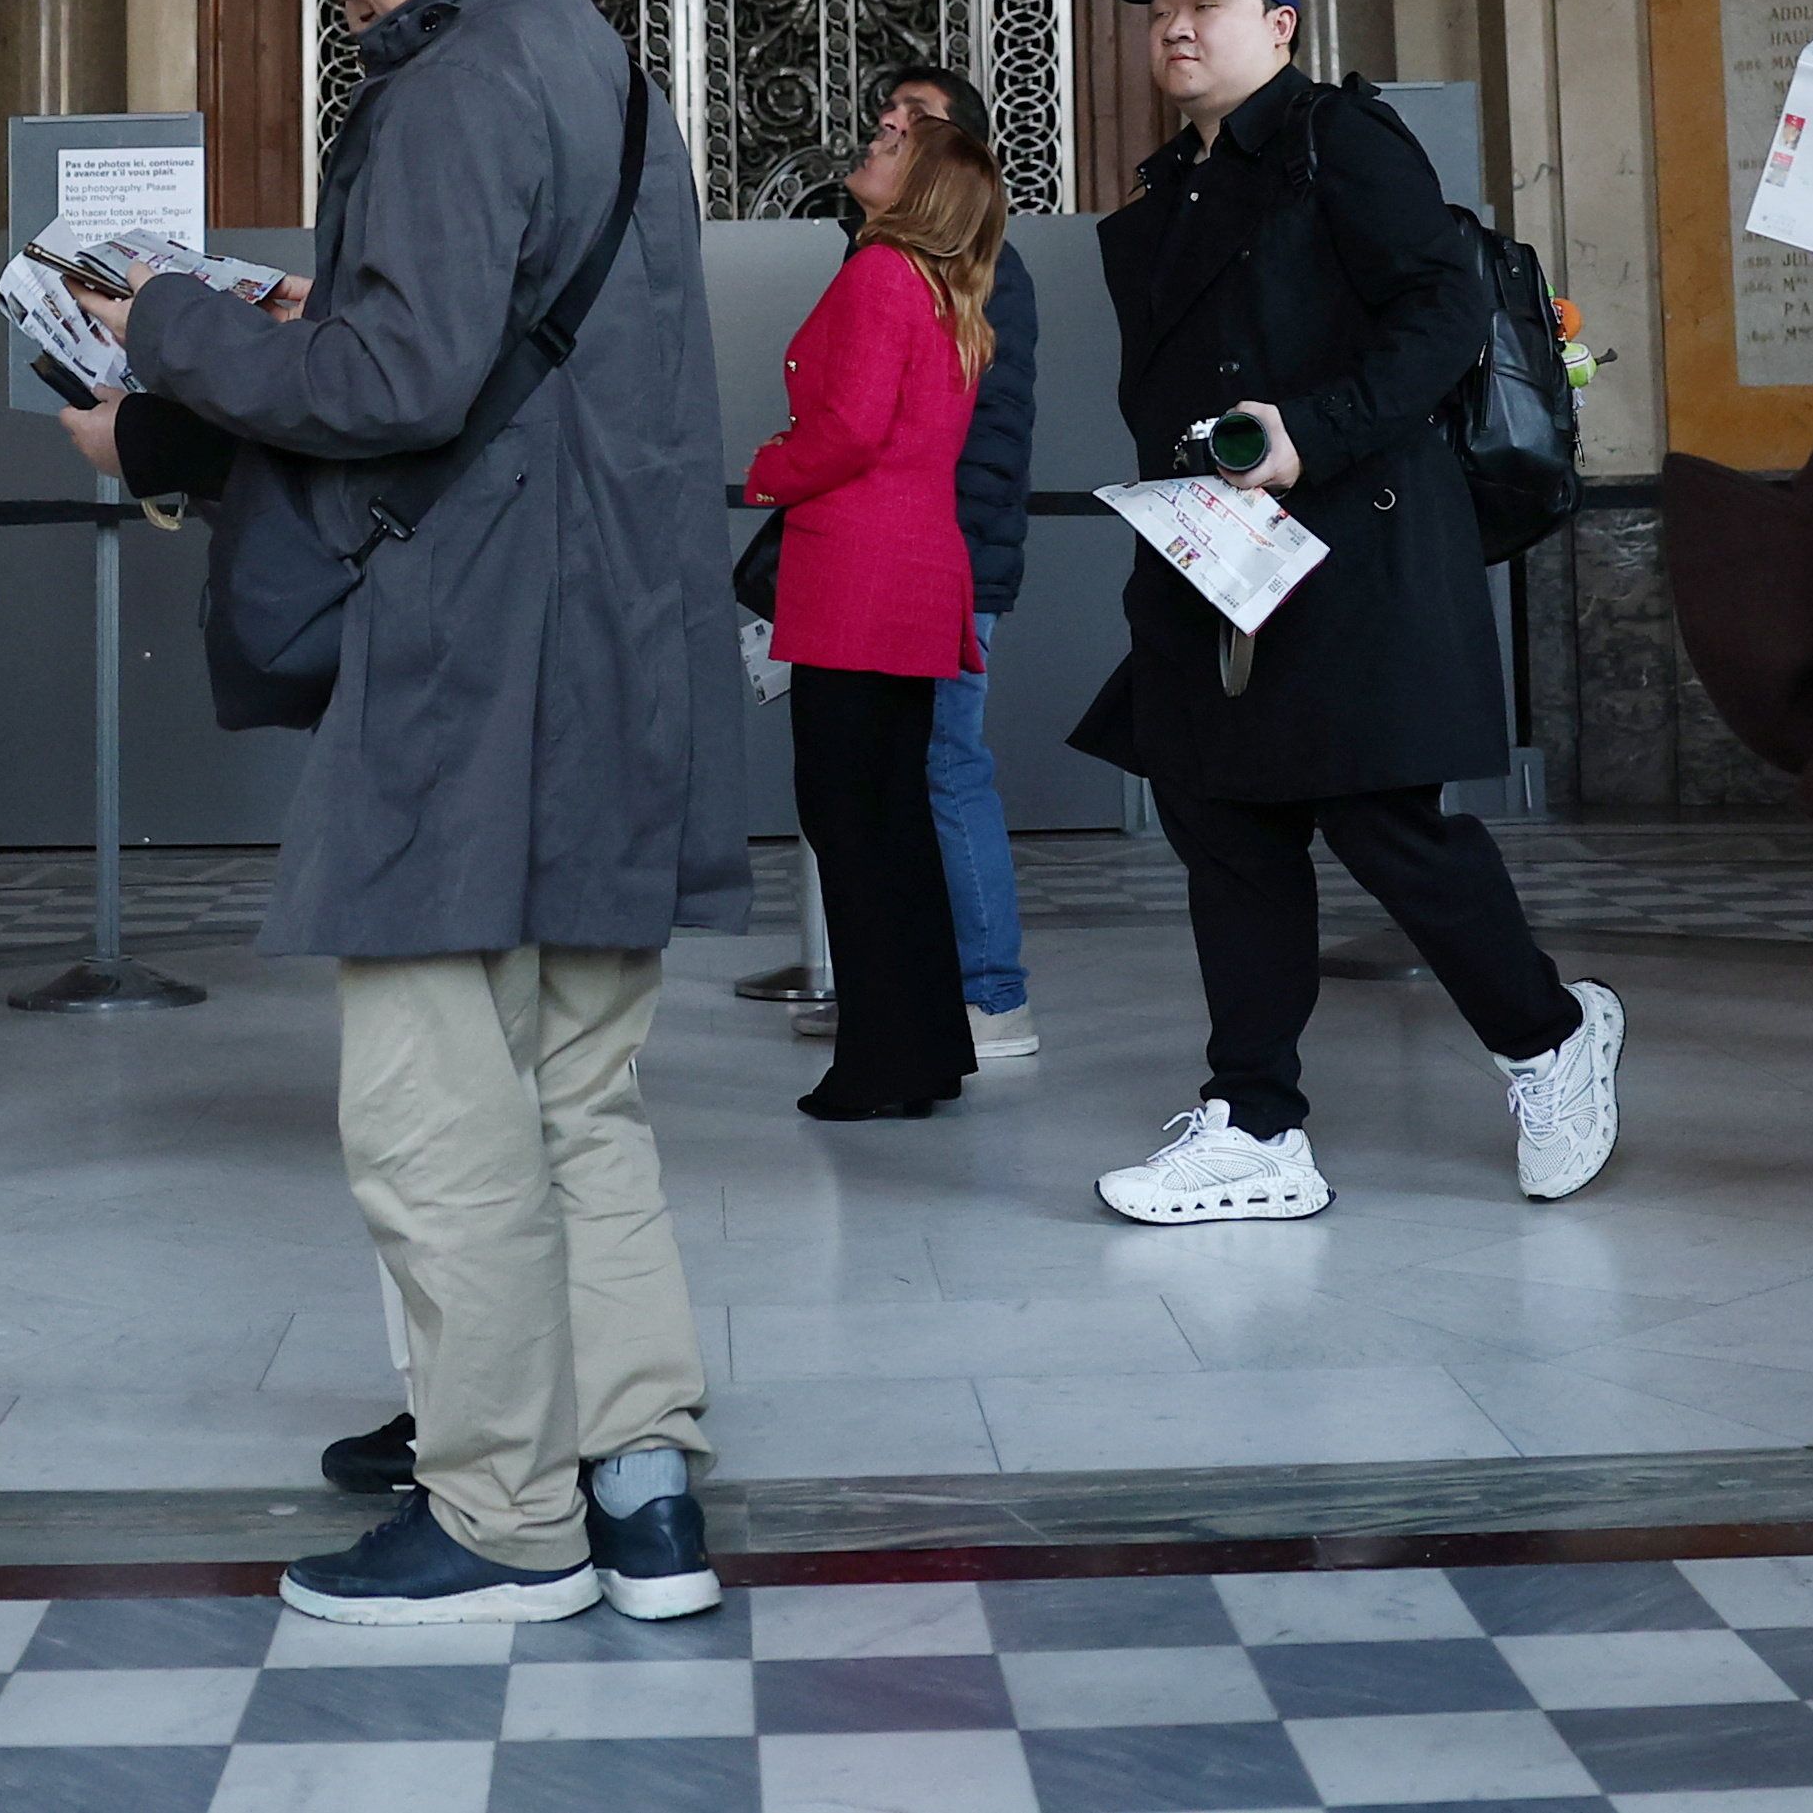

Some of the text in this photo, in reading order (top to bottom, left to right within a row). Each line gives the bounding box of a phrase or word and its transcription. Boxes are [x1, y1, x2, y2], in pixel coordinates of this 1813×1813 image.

[65, 160, 82, 169] Pas
[84, 160, 96, 168] de
[98, 159, 131, 170] photos
[148, 159, 195, 167] continuez
[74, 170, 109, 178] avancer
[65, 184, 79, 193] No
[146, 182, 177, 191] Please
[65, 192, 88, 203] keep
[65, 209, 79, 217] No
[82, 208, 107, 217] hacer
[110, 207, 134, 216] fotos
[161, 206, 192, 217] Seguir
[121, 218, 137, 229] por
